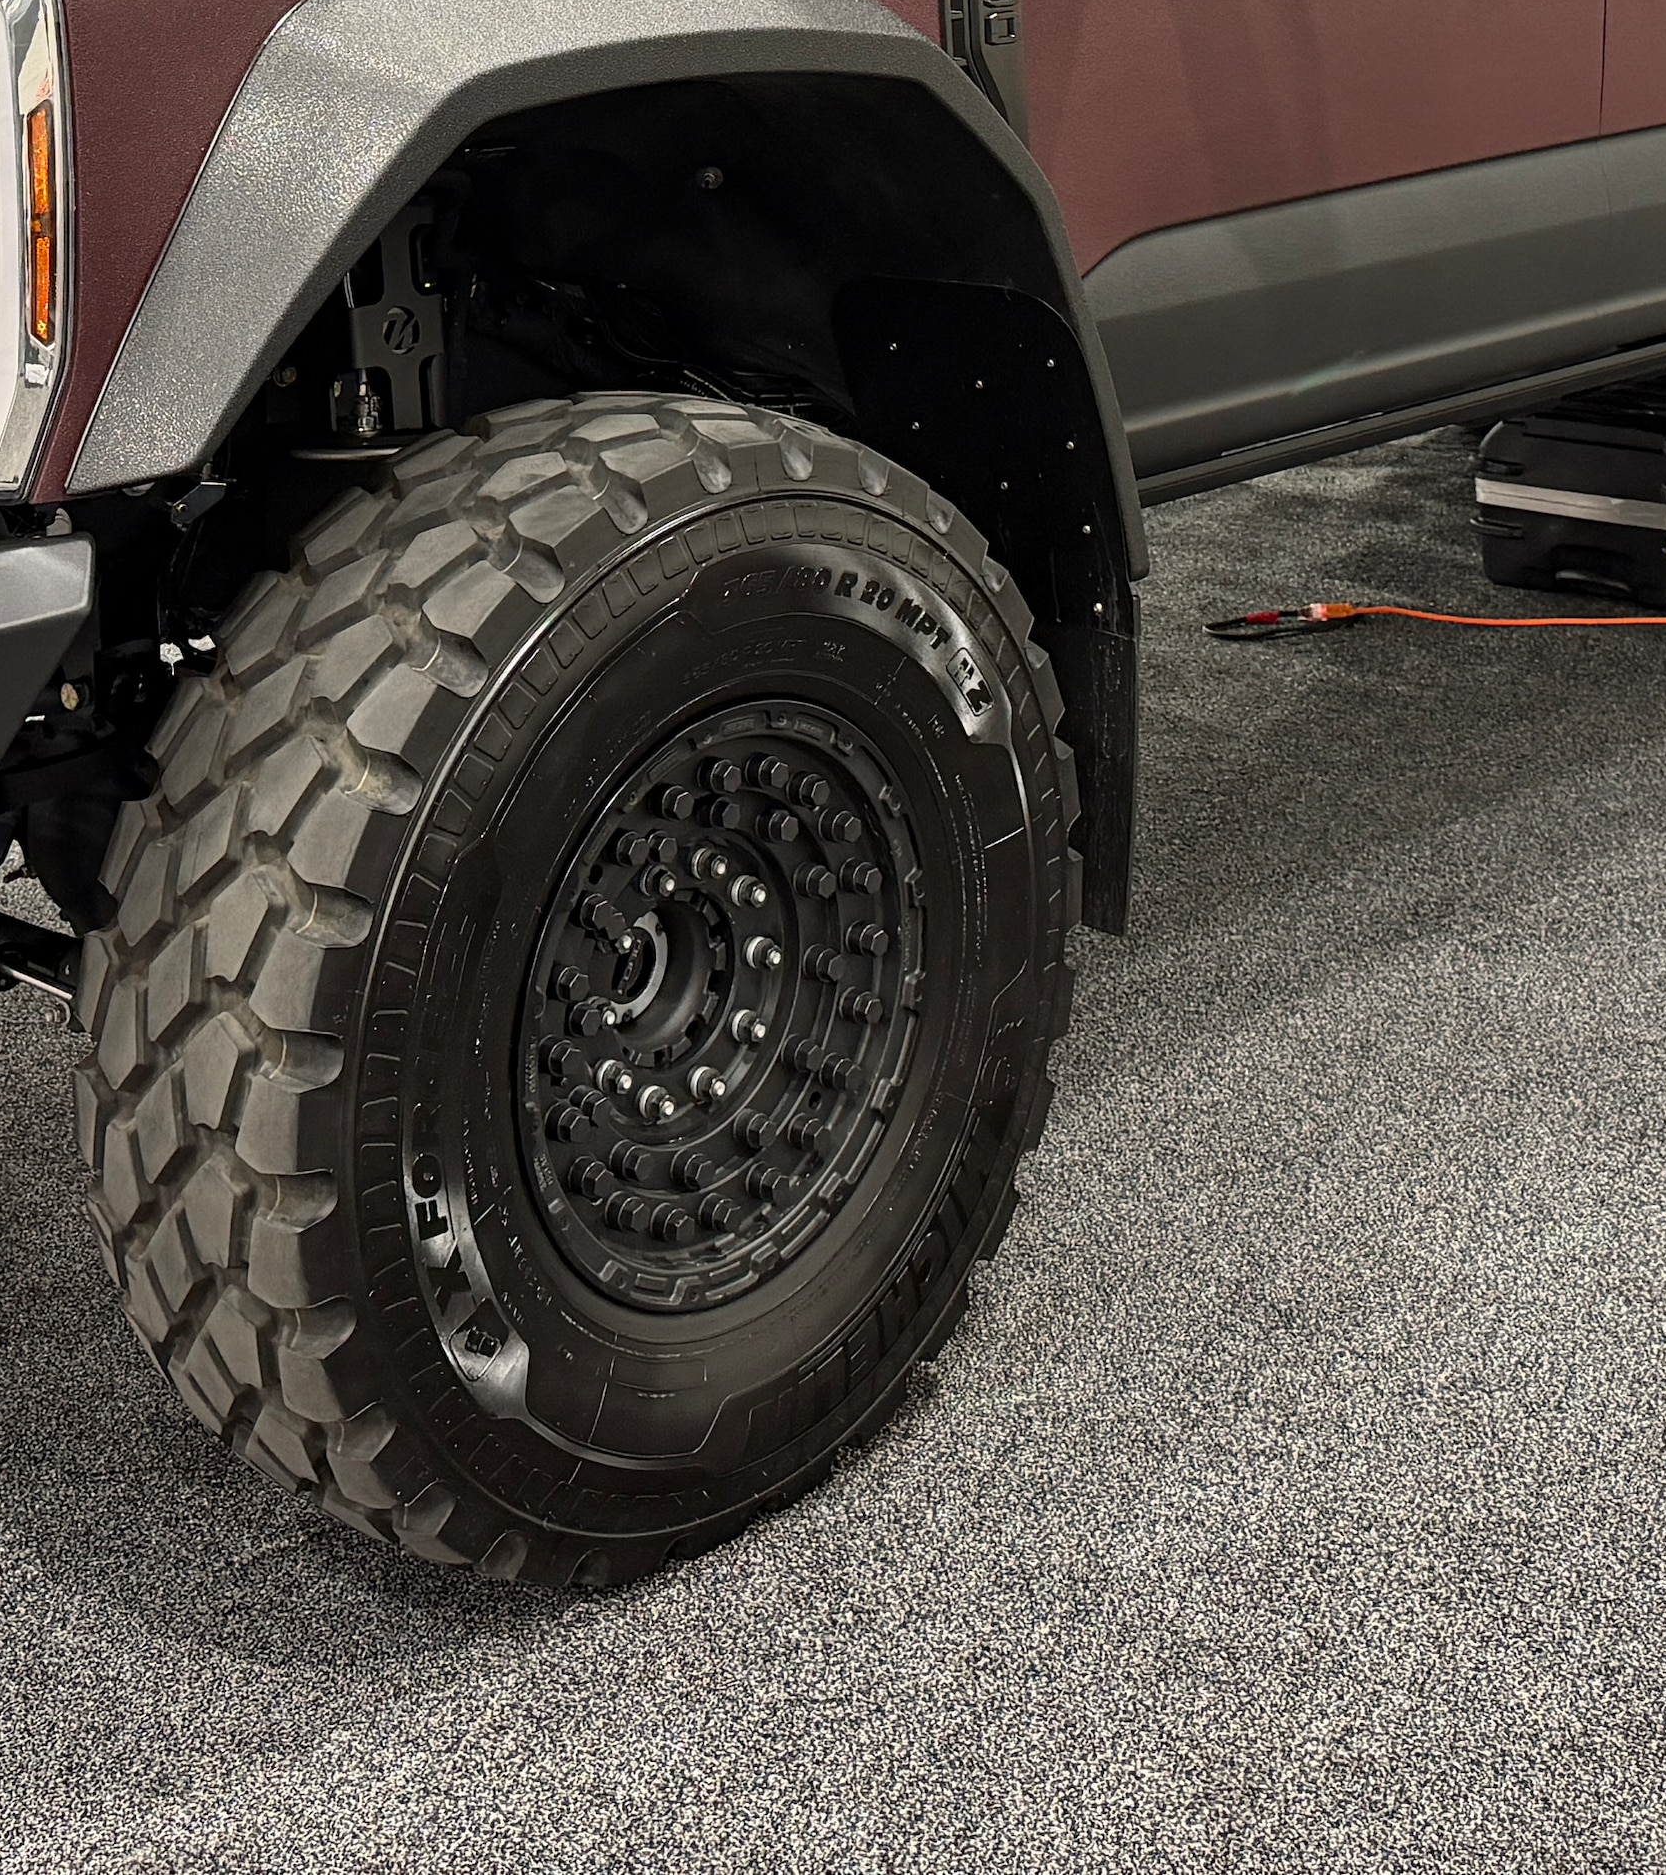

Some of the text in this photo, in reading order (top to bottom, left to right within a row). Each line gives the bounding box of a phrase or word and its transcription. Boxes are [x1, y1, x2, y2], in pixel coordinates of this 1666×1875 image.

[834, 571, 859, 598] R
[859, 579, 897, 611] 20
[895, 597, 953, 651] MPT
